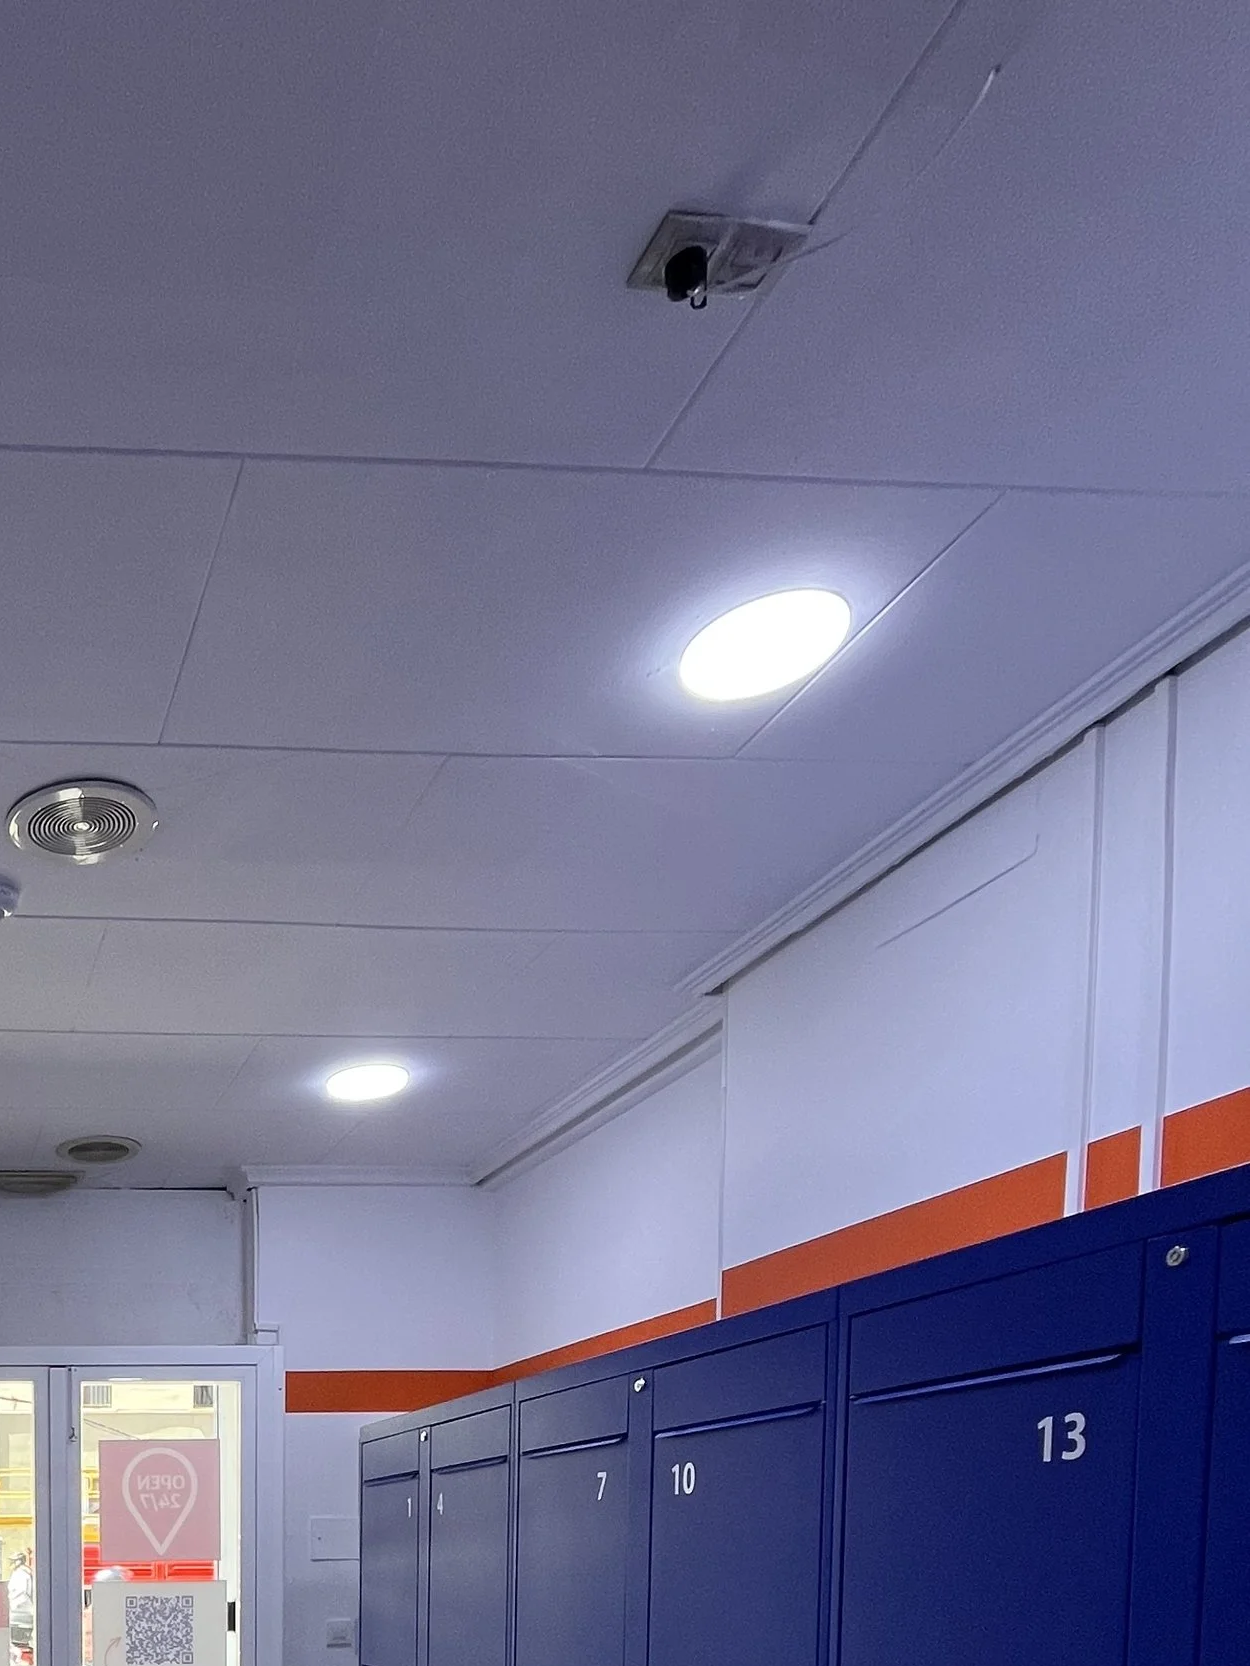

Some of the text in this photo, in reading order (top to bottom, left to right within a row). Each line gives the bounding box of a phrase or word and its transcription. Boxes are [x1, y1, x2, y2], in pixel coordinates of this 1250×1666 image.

[1037, 1412, 1086, 1463] 13
[596, 1471, 608, 1501] 7
[671, 1462, 696, 1495] 10
[435, 1492, 445, 1515] 4
